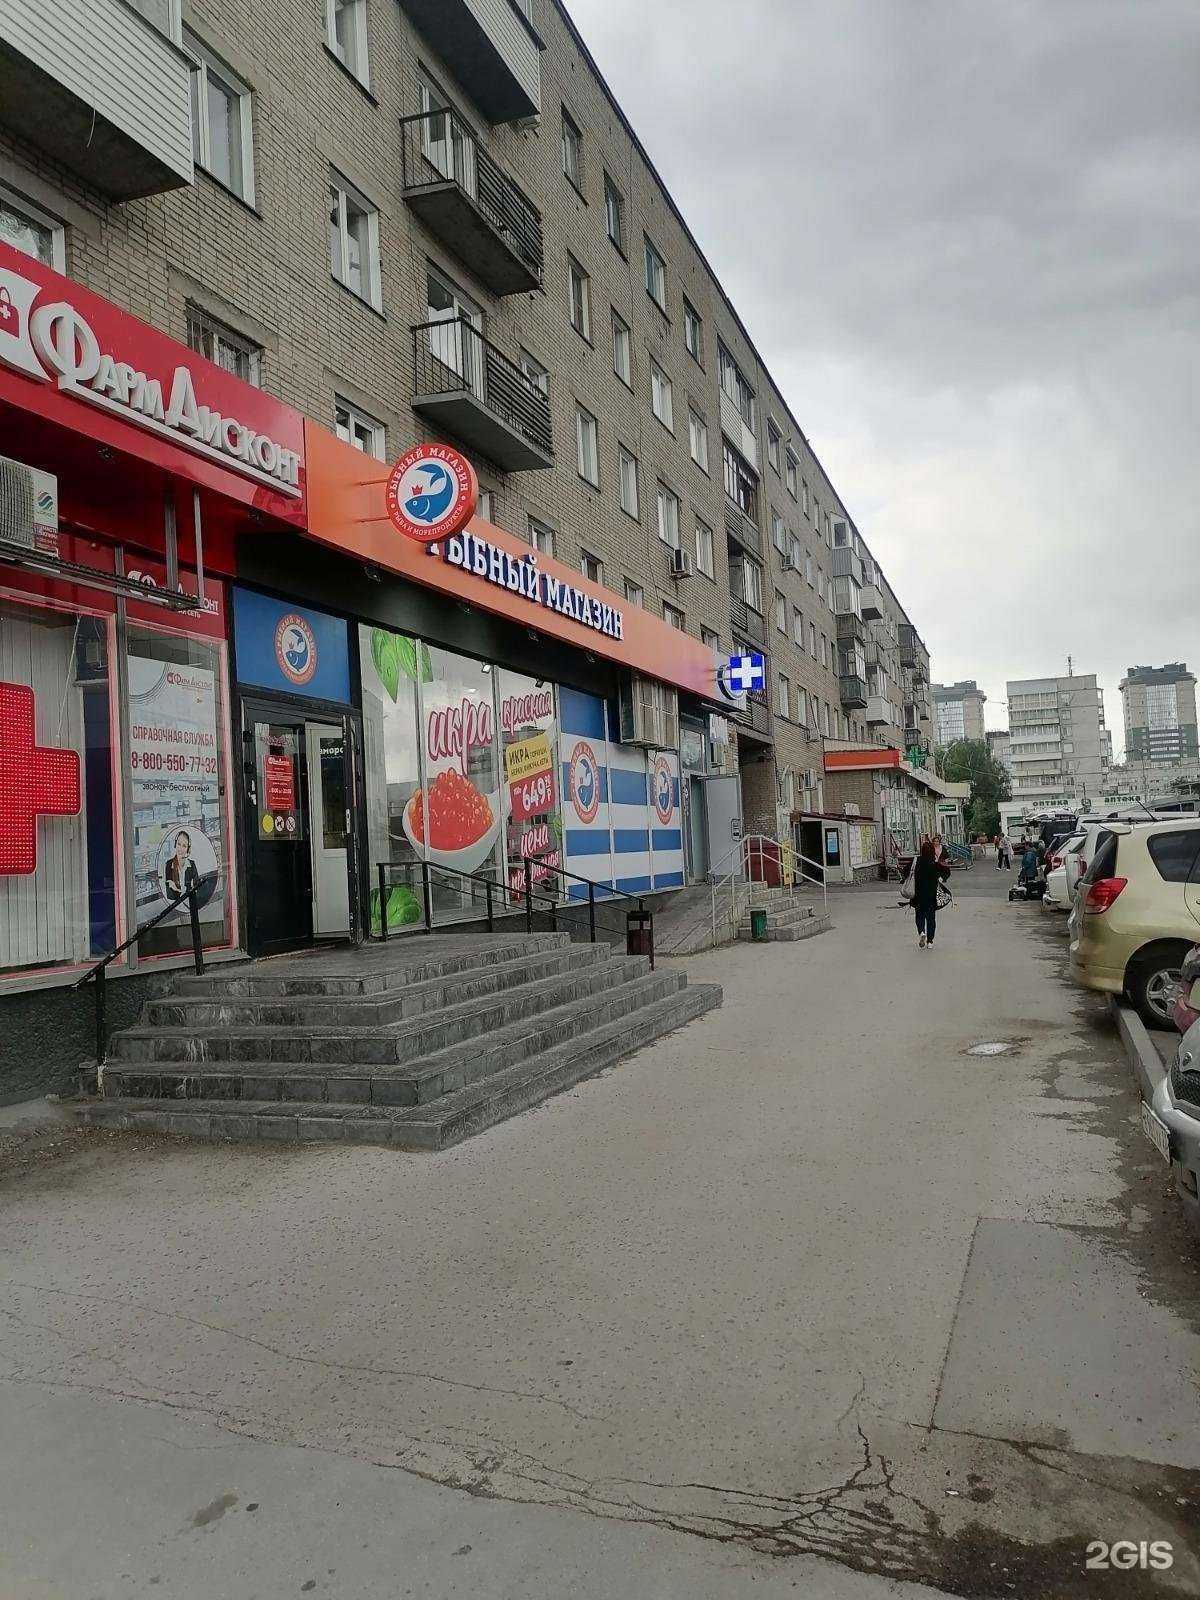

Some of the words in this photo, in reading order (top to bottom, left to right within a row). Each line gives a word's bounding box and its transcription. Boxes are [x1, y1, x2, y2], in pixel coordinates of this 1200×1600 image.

[389, 447, 423, 499] РЫБНЫЙ
[429, 447, 469, 491] МАГАЗИН
[547, 573, 624, 641] МАГАЗИН
[132, 725, 182, 744] СПРАВОЧНАЯ
[184, 731, 215, 747] СЛУЖБА
[427, 697, 492, 779] икра
[502, 691, 552, 737] красная
[131, 750, 217, 775] 8-800-550-77-32
[508, 747, 530, 767] ИКРА
[142, 783, 168, 791] звонок
[169, 783, 210, 793] бесплатный
[522, 777, 546, 812] 649
